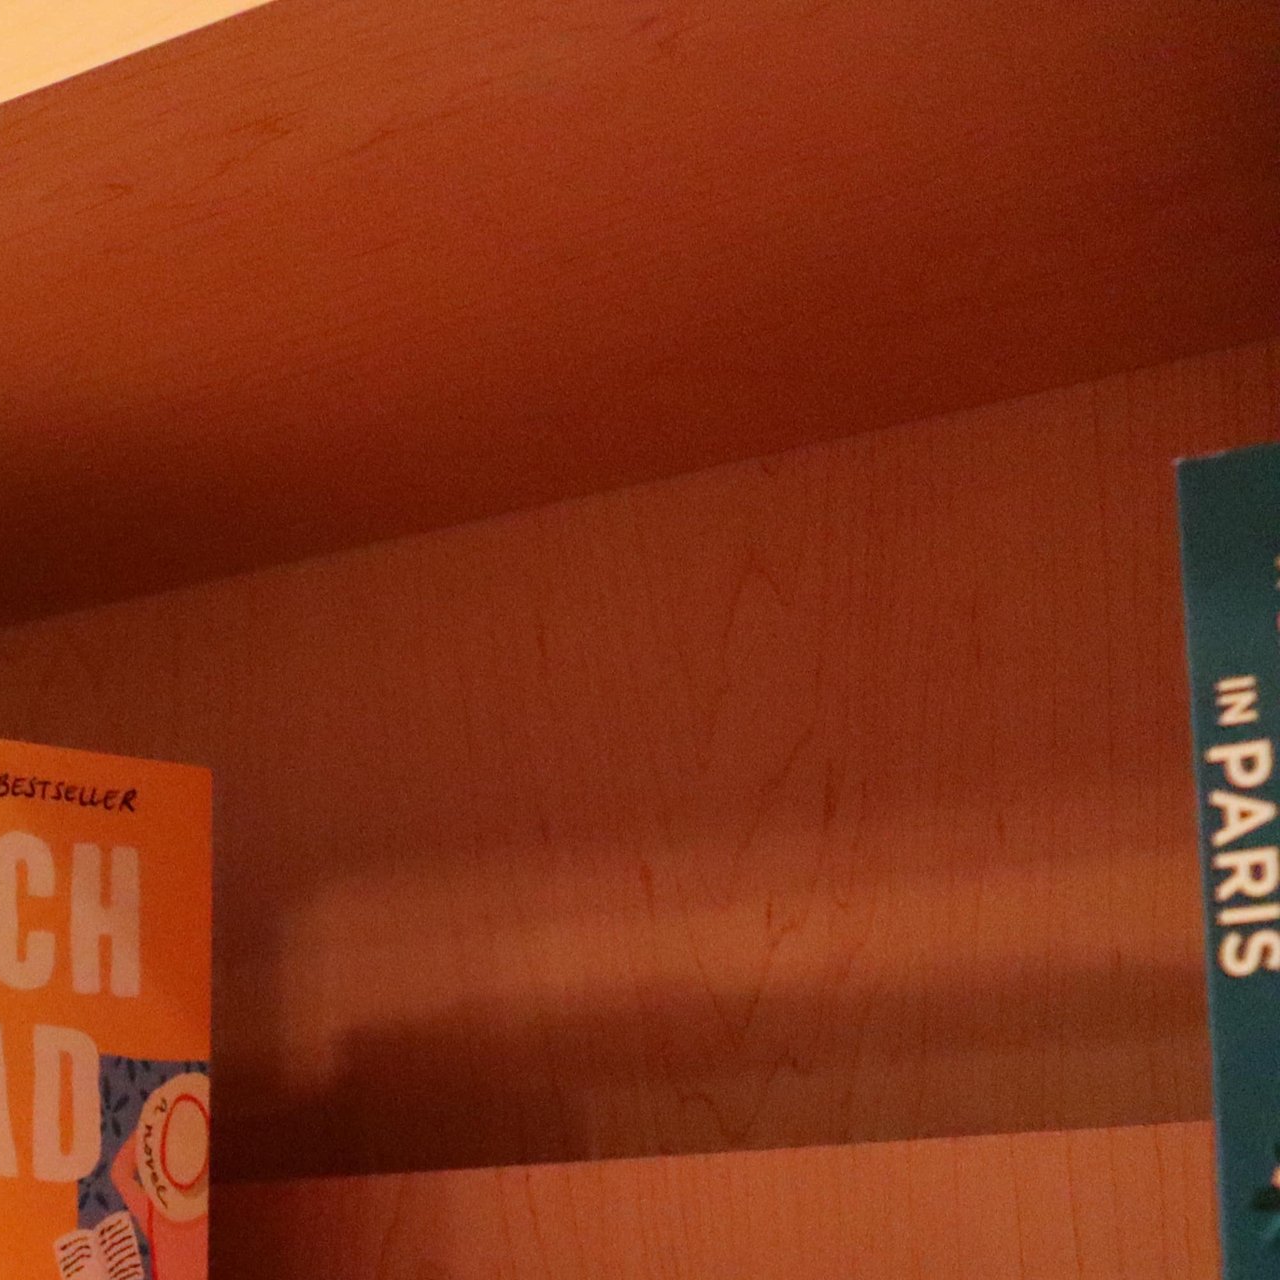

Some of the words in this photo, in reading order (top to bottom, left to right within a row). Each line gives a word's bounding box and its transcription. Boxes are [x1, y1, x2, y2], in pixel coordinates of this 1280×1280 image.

[1214, 675, 1259, 727] IN
[1204, 737, 1280, 979] PARIS
[142, 1123, 168, 1208] novel
